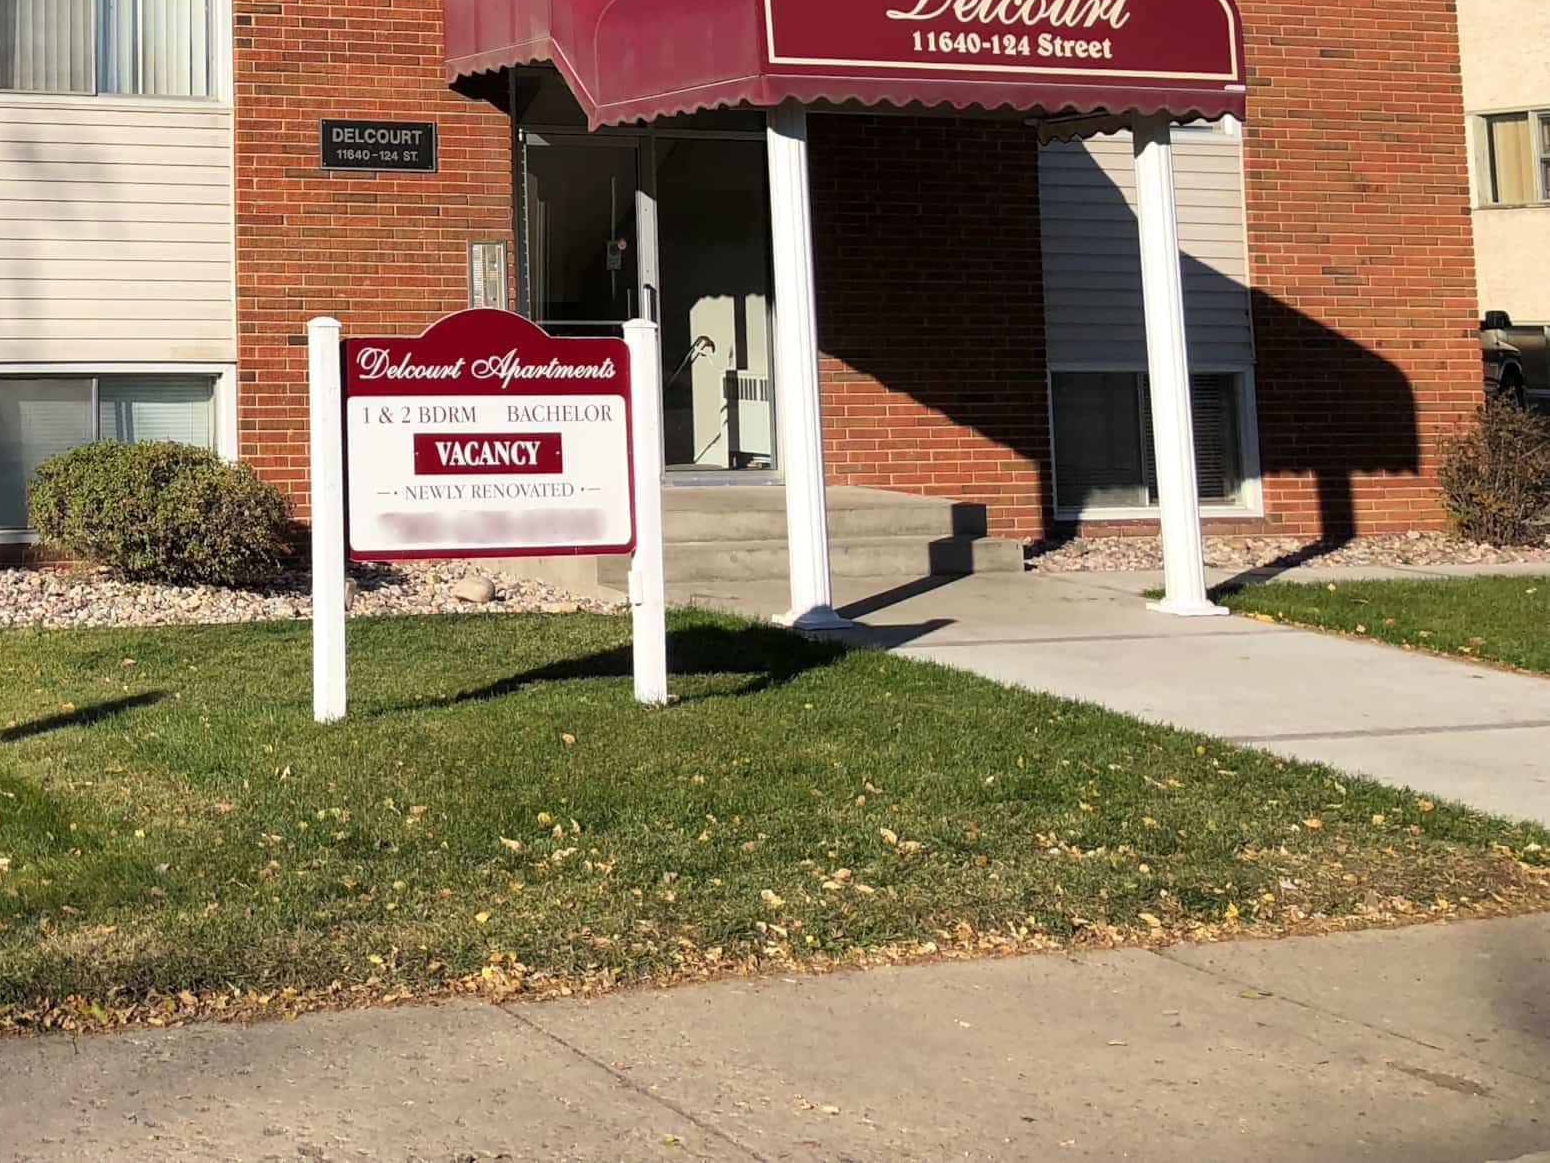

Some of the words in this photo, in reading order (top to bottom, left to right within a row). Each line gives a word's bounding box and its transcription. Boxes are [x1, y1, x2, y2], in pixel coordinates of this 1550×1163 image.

[912, 31, 1031, 55] 11640-124
[1037, 33, 1113, 59] Street
[332, 128, 423, 145] DELCOURT
[403, 151, 419, 162] ST.
[356, 347, 466, 380] Delcourt
[471, 348, 616, 389] Apartments
[363, 406, 370, 424] 1
[378, 406, 394, 424] &
[401, 406, 411, 424] 2
[419, 406, 477, 424] BDRM
[507, 404, 613, 423] BACHELOR
[434, 440, 541, 467] VACANCY
[405, 485, 466, 500] NEWLY
[471, 482, 575, 499] RENOVATED
